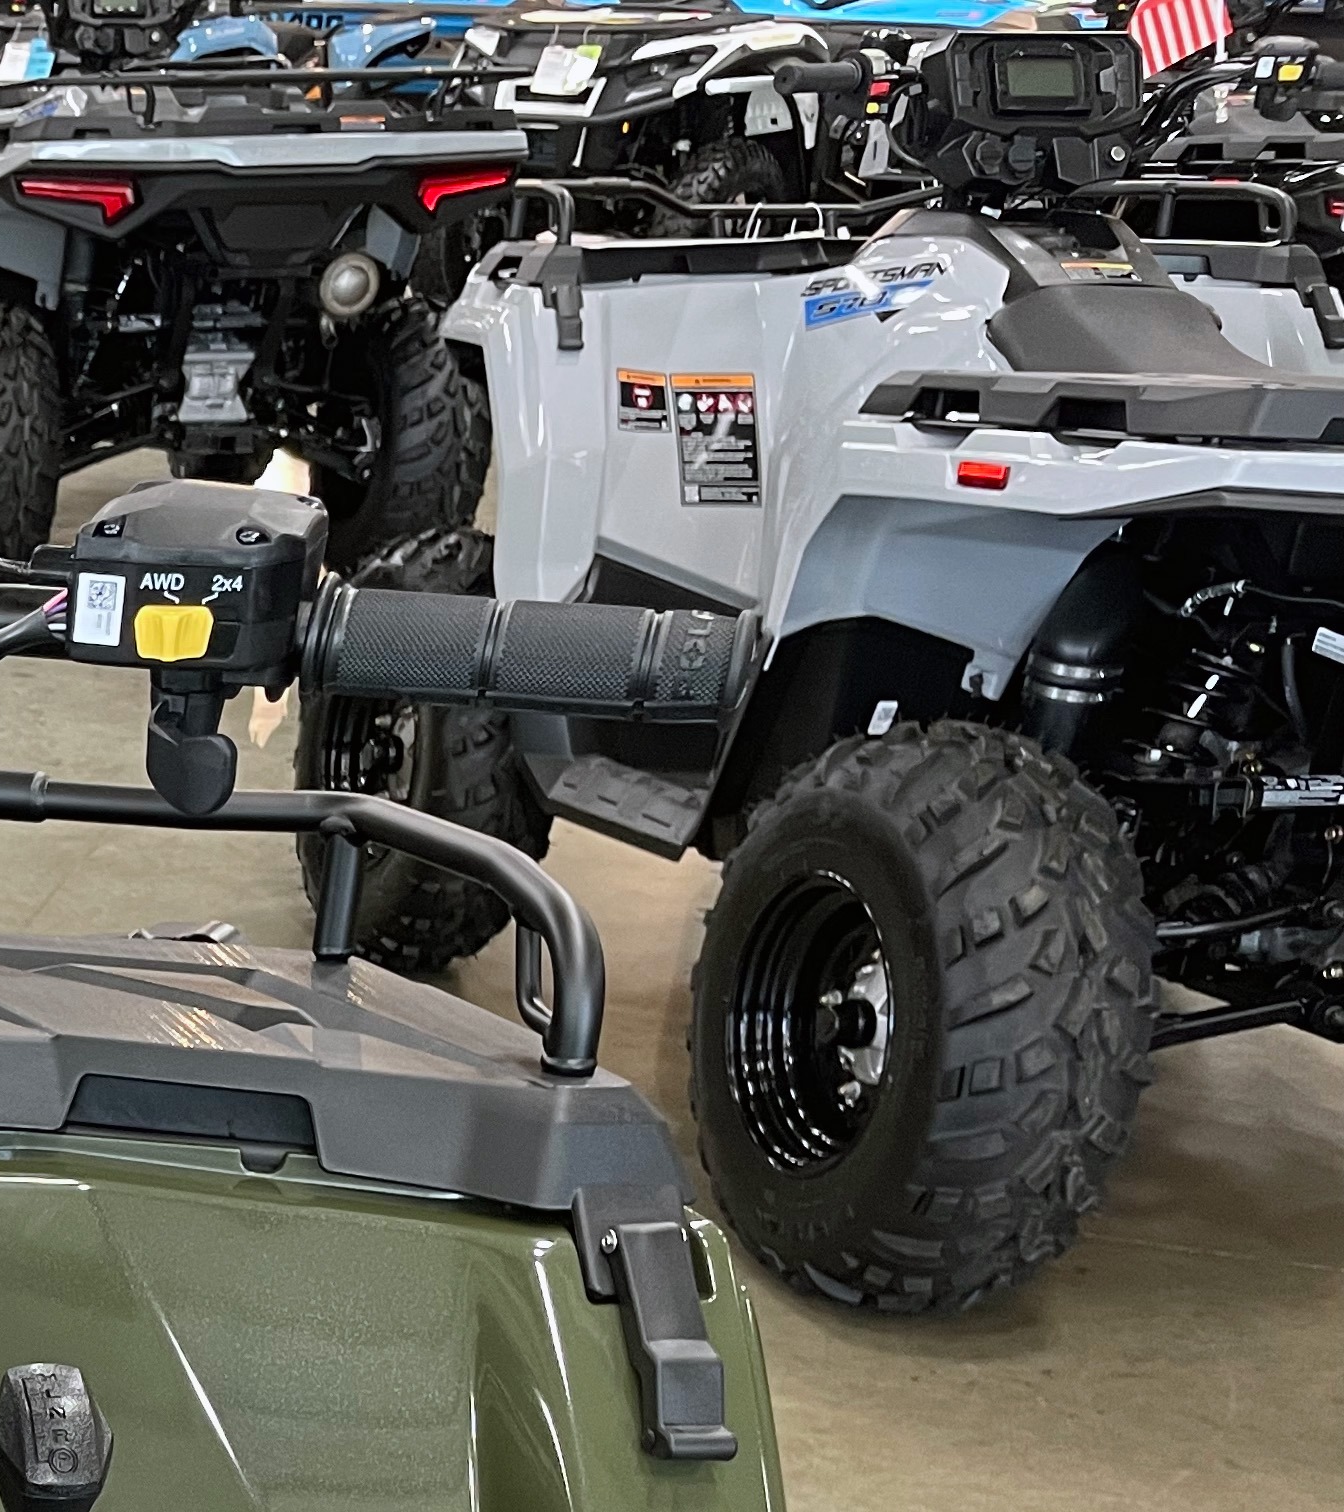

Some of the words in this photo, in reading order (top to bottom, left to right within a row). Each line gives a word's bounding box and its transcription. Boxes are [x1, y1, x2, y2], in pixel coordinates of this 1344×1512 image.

[800, 261, 947, 298] SPOTSMAN
[140, 572, 185, 591] AWD
[212, 574, 244, 592] 2x4
[49, 1406, 67, 1419] N
[52, 1429, 69, 1443] R
